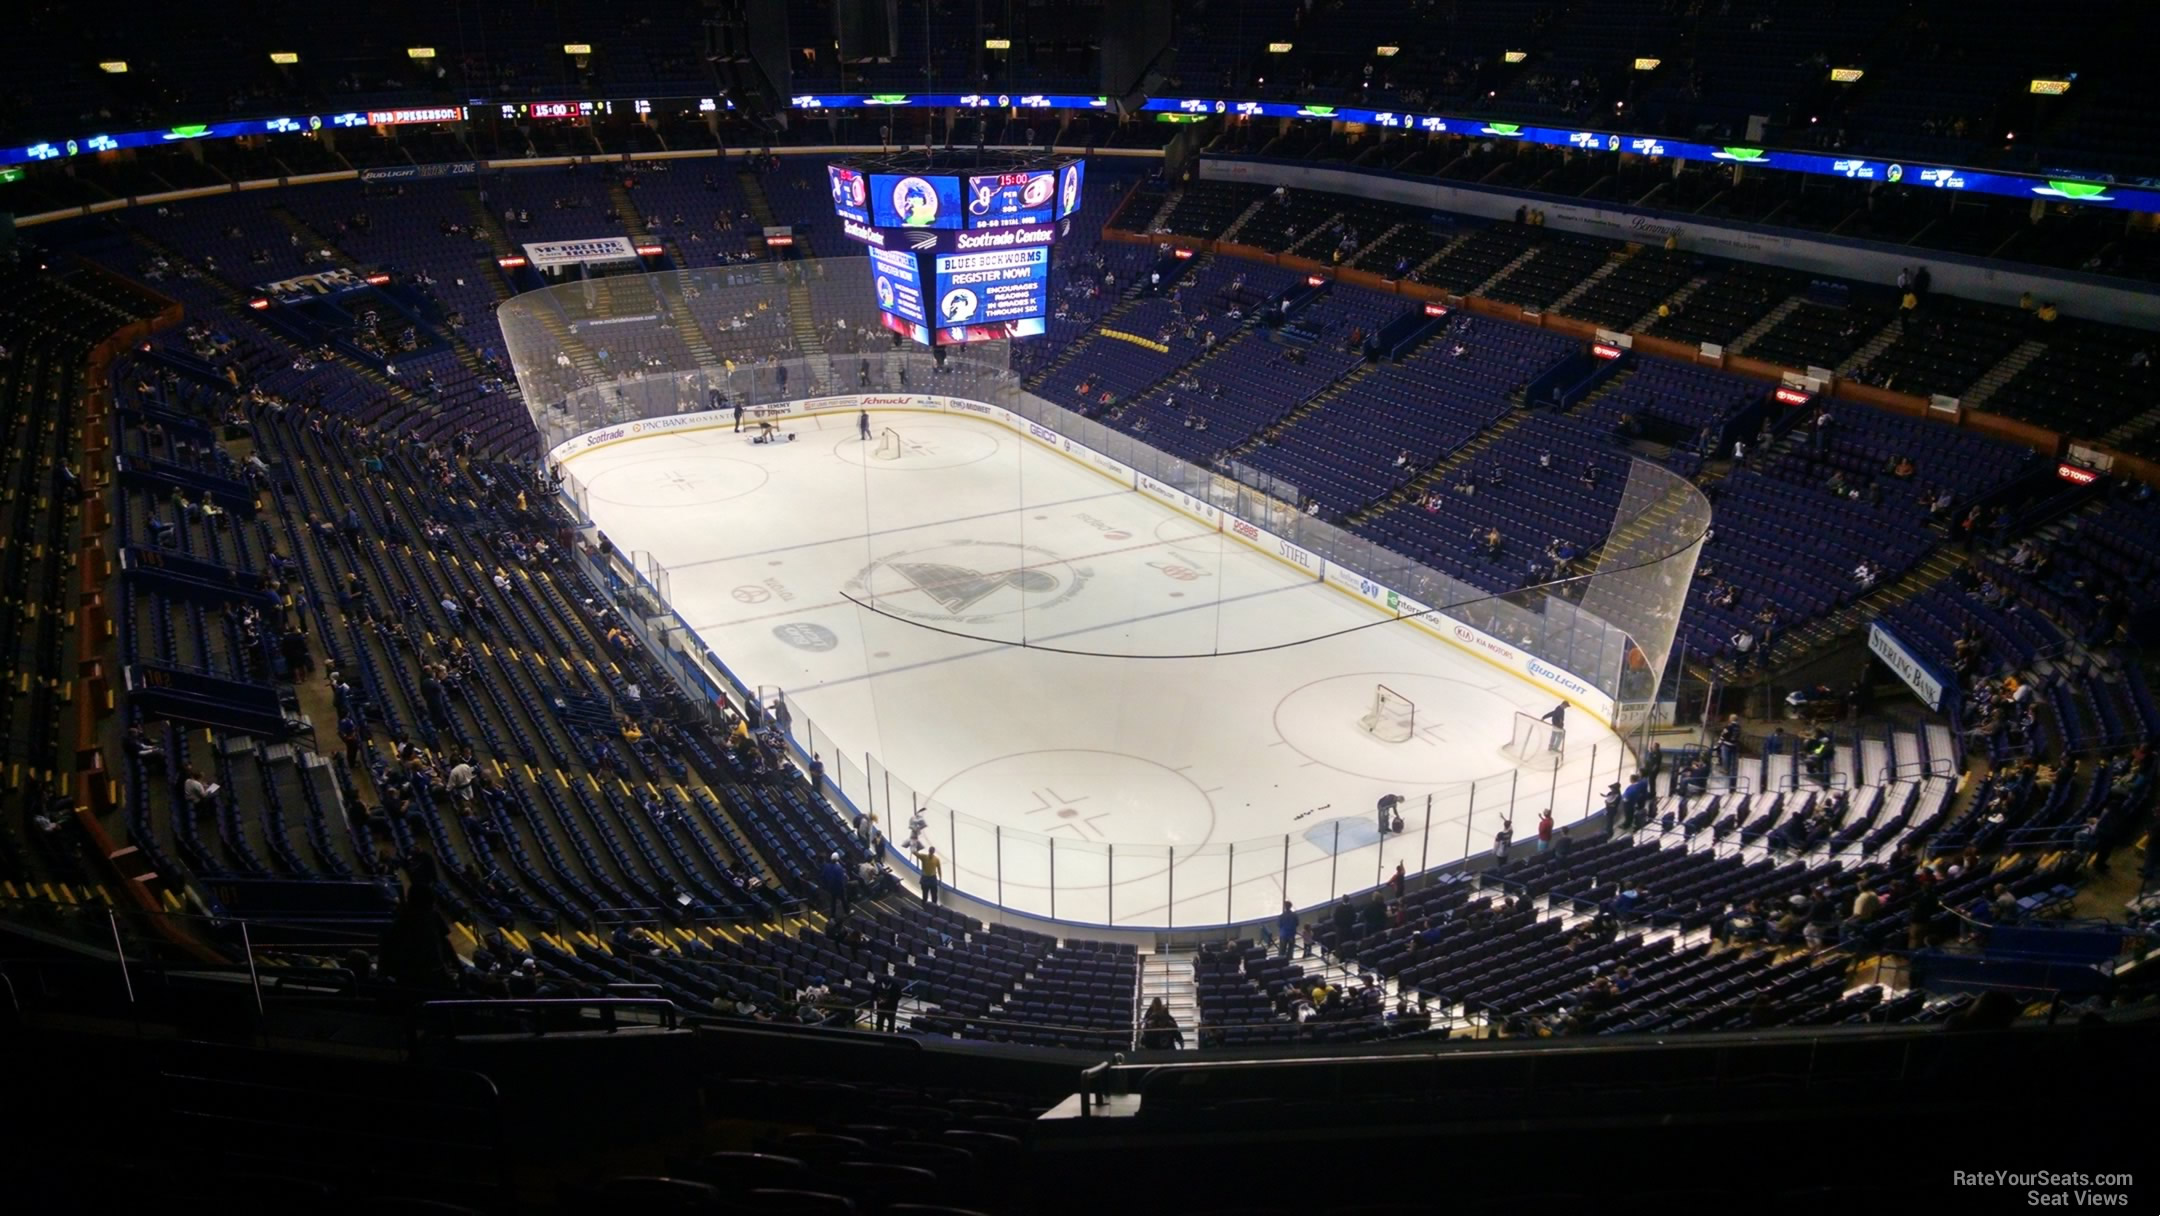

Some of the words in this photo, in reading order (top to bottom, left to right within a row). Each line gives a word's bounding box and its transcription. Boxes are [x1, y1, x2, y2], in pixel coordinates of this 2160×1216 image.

[502, 105, 516, 113] STL
[520, 104, 528, 113] 0
[535, 104, 567, 116] 15:00
[372, 112, 394, 123] NBA
[396, 109, 458, 122] PRESEASON:
[387, 170, 415, 178] LIGHT
[452, 164, 476, 174] ZONE
[1000, 174, 1028, 186] 15:00
[1001, 218, 1018, 226] TOTAL
[1632, 216, 1685, 236] Bommarito
[957, 231, 1015, 249] Scottrade
[1015, 228, 1053, 244] Center
[566, 248, 625, 257] HOMES
[944, 257, 976, 270] BLUES
[979, 251, 1042, 266] BOOKWORMS
[952, 270, 1001, 284] REGISTER
[1003, 267, 1031, 280] NOW!
[986, 282, 1038, 294] ENCOURAGES
[995, 291, 1029, 301] READING
[997, 298, 1027, 308] GRADES
[986, 307, 1023, 317] THROUGH
[861, 396, 912, 405] Schnucks
[767, 408, 791, 417] JOHN'S
[965, 403, 991, 415] MIDWEST
[642, 422, 661, 431] PNC
[662, 417, 687, 427] BANK
[587, 428, 624, 446] Scottrade
[1030, 423, 1056, 445] GEICO
[1233, 519, 1259, 538] DOBBS
[1279, 540, 1310, 569] STIFEL
[1390, 596, 1440, 625] enterprise
[1456, 629, 1472, 640] KIA
[1476, 637, 1487, 647] KIA
[1487, 641, 1514, 660] MOTORS
[1872, 628, 1913, 680] STERLING
[1912, 668, 1937, 702] BANK
[1530, 662, 1554, 680] BUD
[1554, 675, 1588, 695] LIGHT
